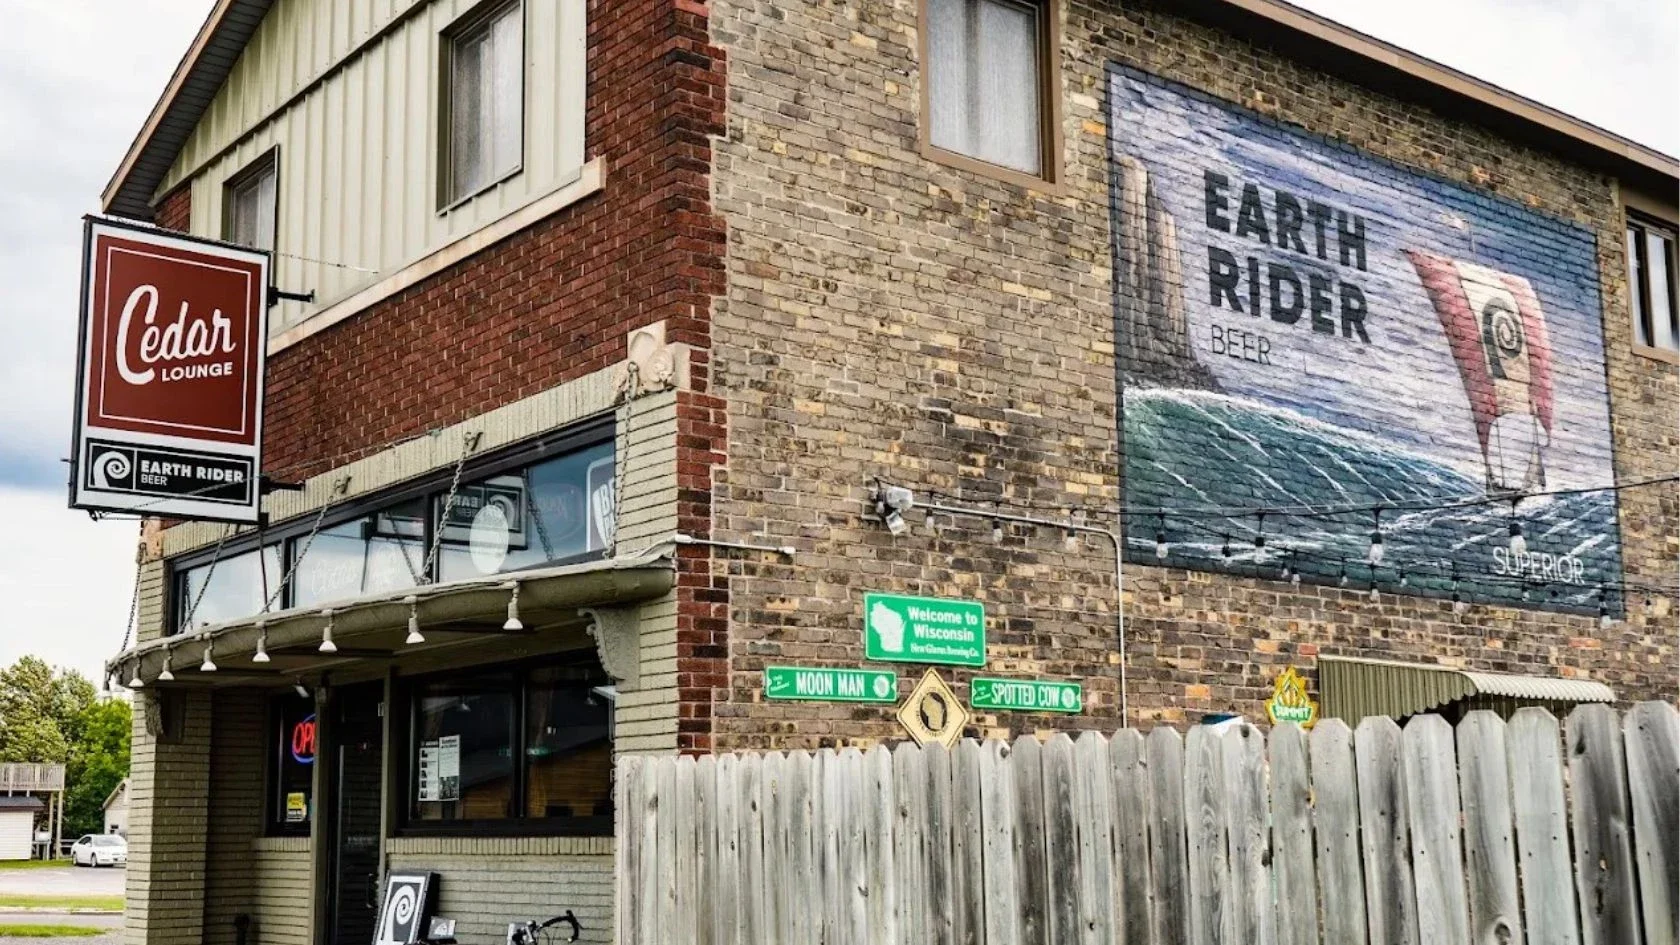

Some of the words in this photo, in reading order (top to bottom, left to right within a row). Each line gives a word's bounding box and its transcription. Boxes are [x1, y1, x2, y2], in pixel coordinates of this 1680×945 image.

[1203, 168, 1368, 272] EARTH
[1207, 244, 1372, 344] RIDER
[116, 284, 237, 386] Cedar
[1211, 324, 1272, 366] BEER
[161, 361, 233, 383] LOUNGE
[140, 459, 192, 478] EARTH
[196, 466, 245, 483] RIDER
[140, 474, 168, 486] BEER
[1492, 546, 1586, 585] SUPERIOR
[907, 606, 963, 625] Welcome
[964, 611, 979, 626] to
[913, 623, 976, 642] Wisconsin
[795, 671, 834, 696] MOON
[837, 672, 866, 697] MAN
[991, 682, 1036, 706] SPOTTED
[1038, 685, 1060, 708] COW
